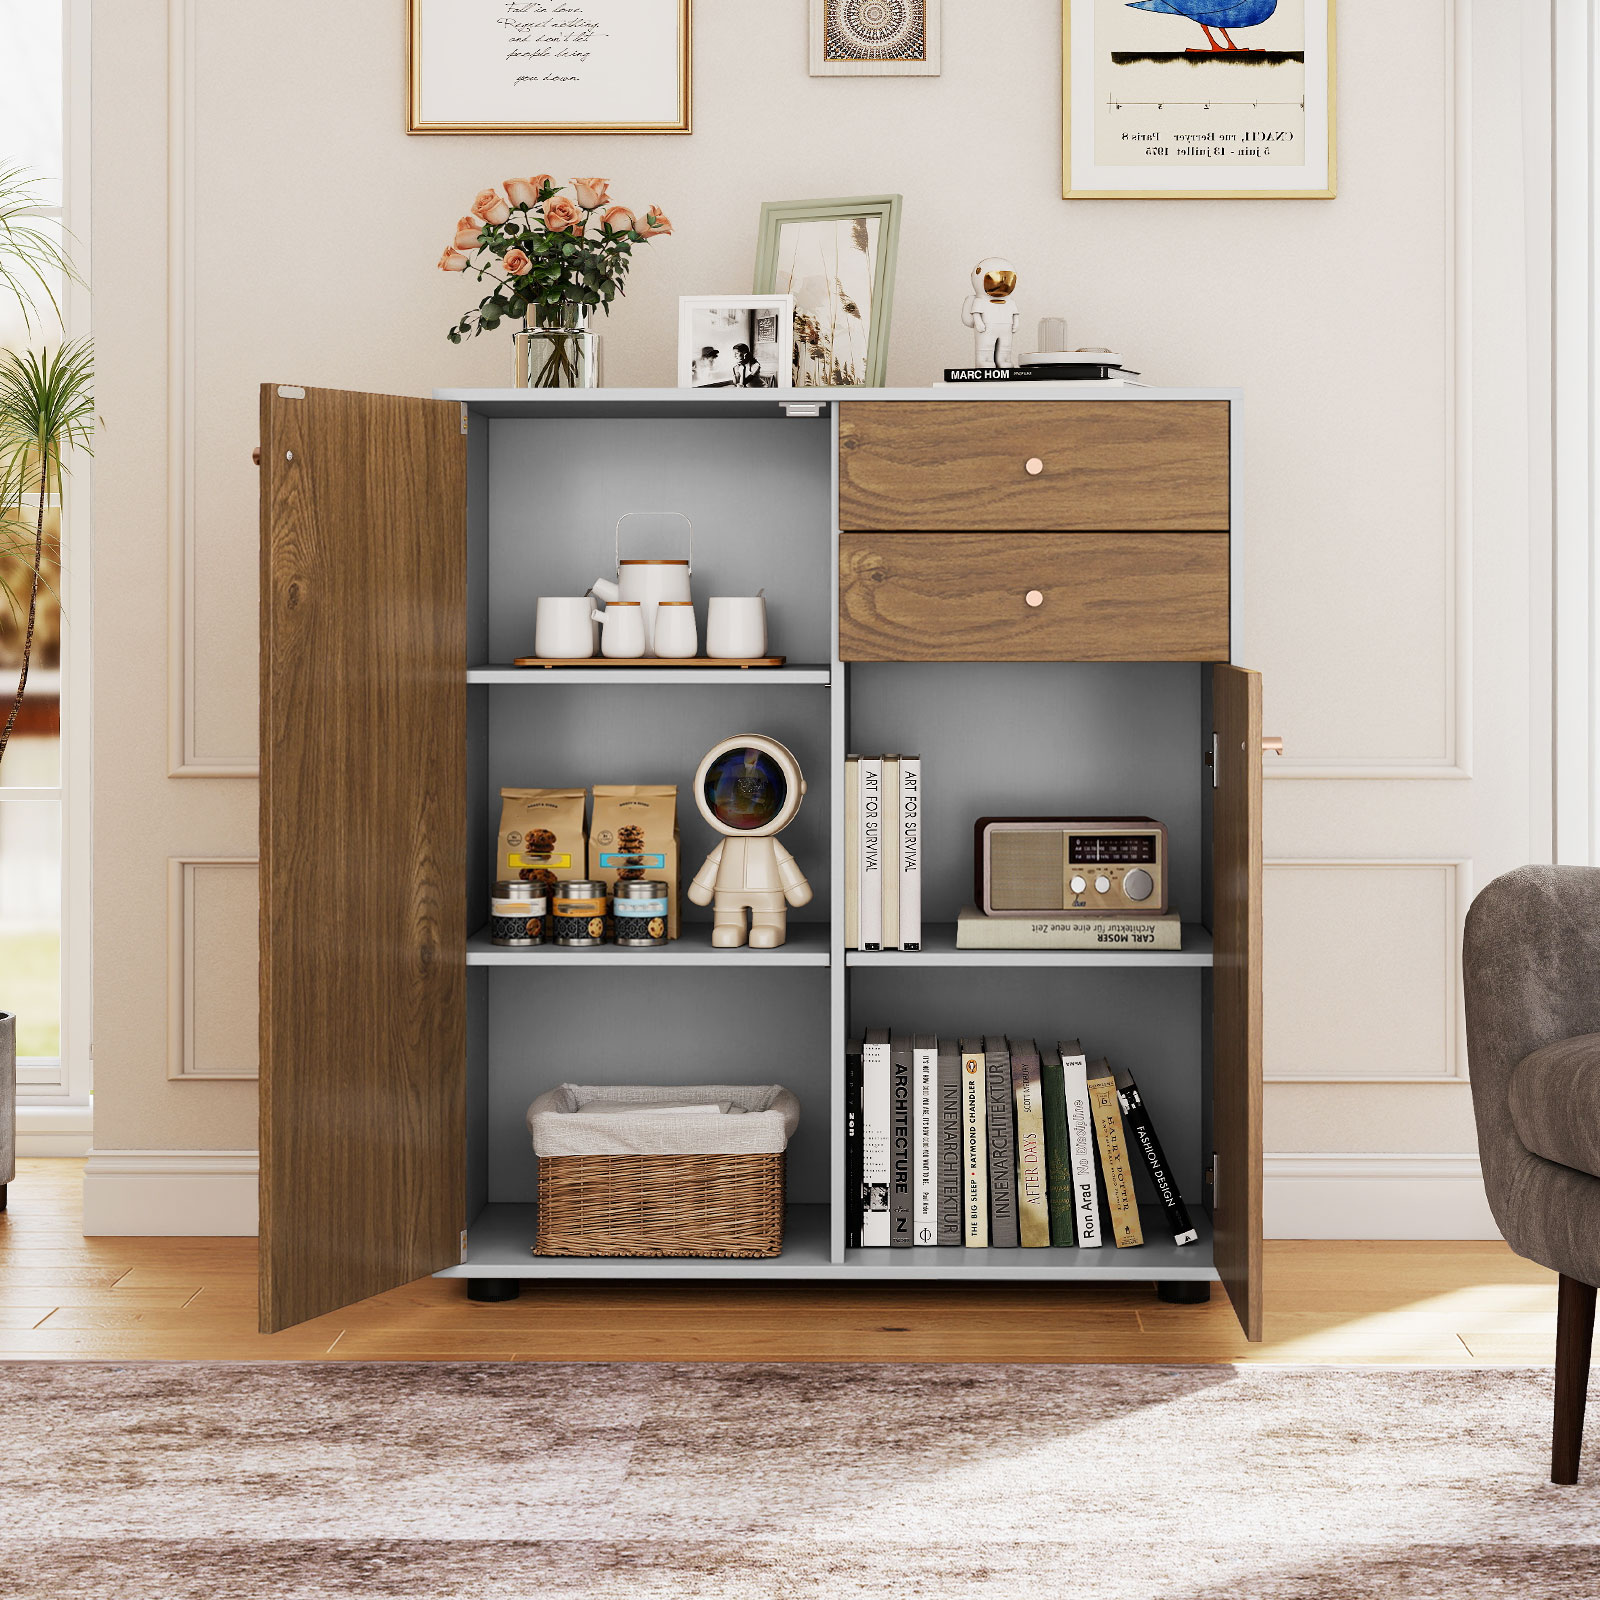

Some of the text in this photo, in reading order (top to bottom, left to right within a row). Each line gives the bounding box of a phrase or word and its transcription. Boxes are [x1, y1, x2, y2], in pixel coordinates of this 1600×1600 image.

[505, 2, 541, 13] Fall
[505, 46, 552, 61] people
[513, 75, 539, 87] you
[951, 370, 982, 380] MARC
[984, 369, 1010, 379] HOM
[866, 771, 878, 872] ART FOR SURVIVAL
[905, 771, 917, 872] ART FOR SURVIVAL
[1031, 924, 1048, 933] Zeit
[1050, 924, 1071, 932] neue
[1073, 924, 1091, 932] eine
[1097, 934, 1155, 942] CARL MOSER
[1107, 924, 1155, 934] Architektur
[968, 1080, 976, 1124] CHANDLER
[895, 1064, 908, 1195] ARCHITECTURE
[989, 1064, 1011, 1219] INNENARCHITEKTUR
[943, 1084, 959, 1234] INNENARCHITEKTUR
[1023, 1132, 1041, 1205] AFTER DAYS
[1073, 1099, 1095, 1239] Ron Arad No Discipline
[1107, 1115, 1129, 1212] HARRY POTTER
[1136, 1125, 1176, 1208] FASHION DESIGN
[970, 1179, 978, 1202] SLEEP
